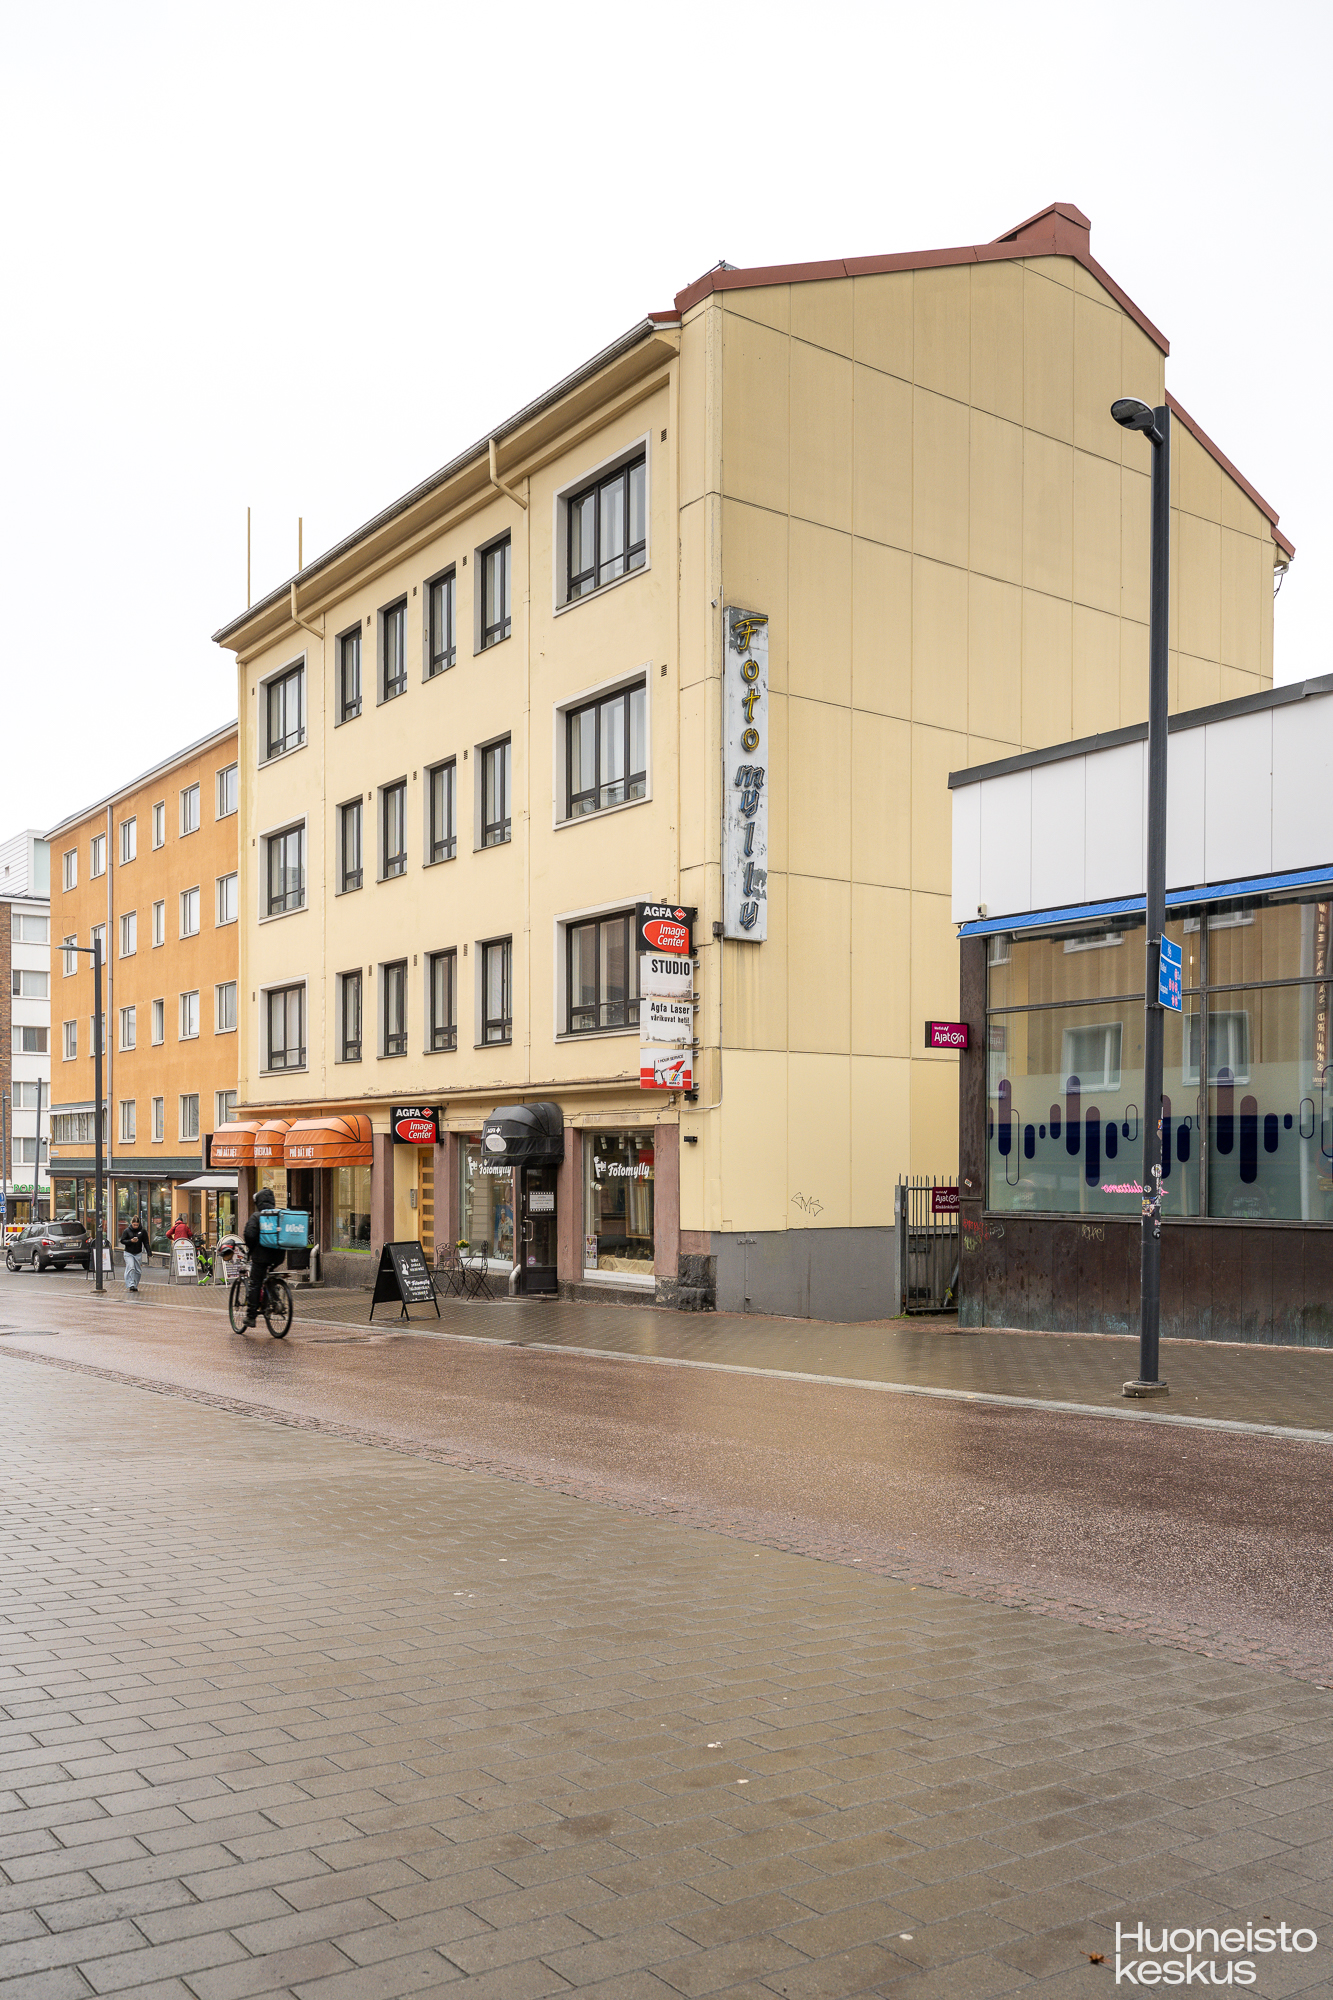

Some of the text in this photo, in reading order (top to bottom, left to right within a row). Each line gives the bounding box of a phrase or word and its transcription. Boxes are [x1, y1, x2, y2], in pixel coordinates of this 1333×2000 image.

[643, 906, 673, 918] AGFA
[660, 923, 686, 939] Image
[657, 935, 685, 947] Center
[651, 958, 690, 976] STUDIO
[650, 1002, 690, 1014] Agfa Laser
[395, 1108, 421, 1117] AGFA
[410, 1121, 433, 1133] Image
[408, 1130, 432, 1139] Center
[607, 1161, 650, 1179] Fotomylly
[13, 1184, 34, 1193] POP
[285, 1223, 305, 1233] Wolt
